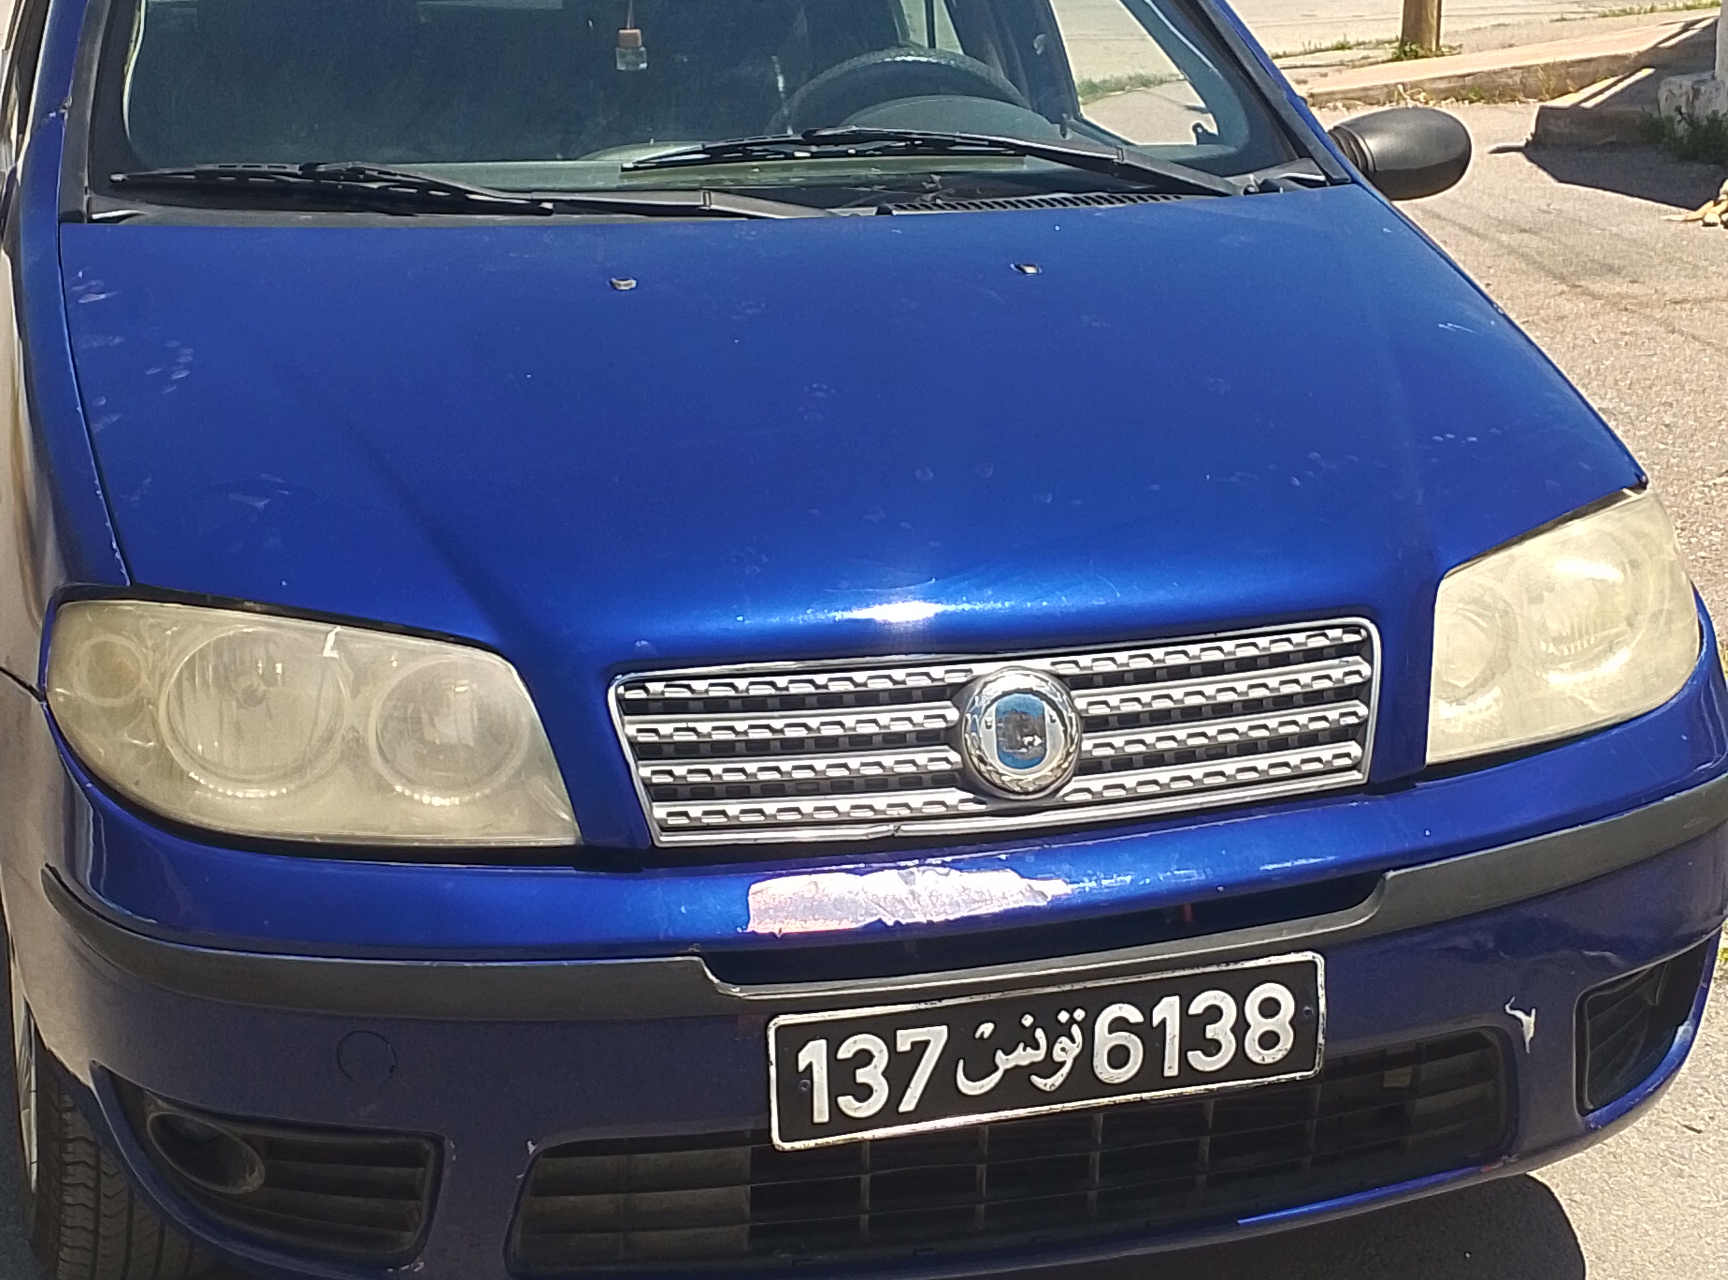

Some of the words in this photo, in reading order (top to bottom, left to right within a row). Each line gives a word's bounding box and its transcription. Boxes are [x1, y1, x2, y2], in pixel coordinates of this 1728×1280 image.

[797, 1024, 949, 1124] 137
[955, 1007, 1087, 1096] تونس
[1092, 981, 1296, 1085] 6138
